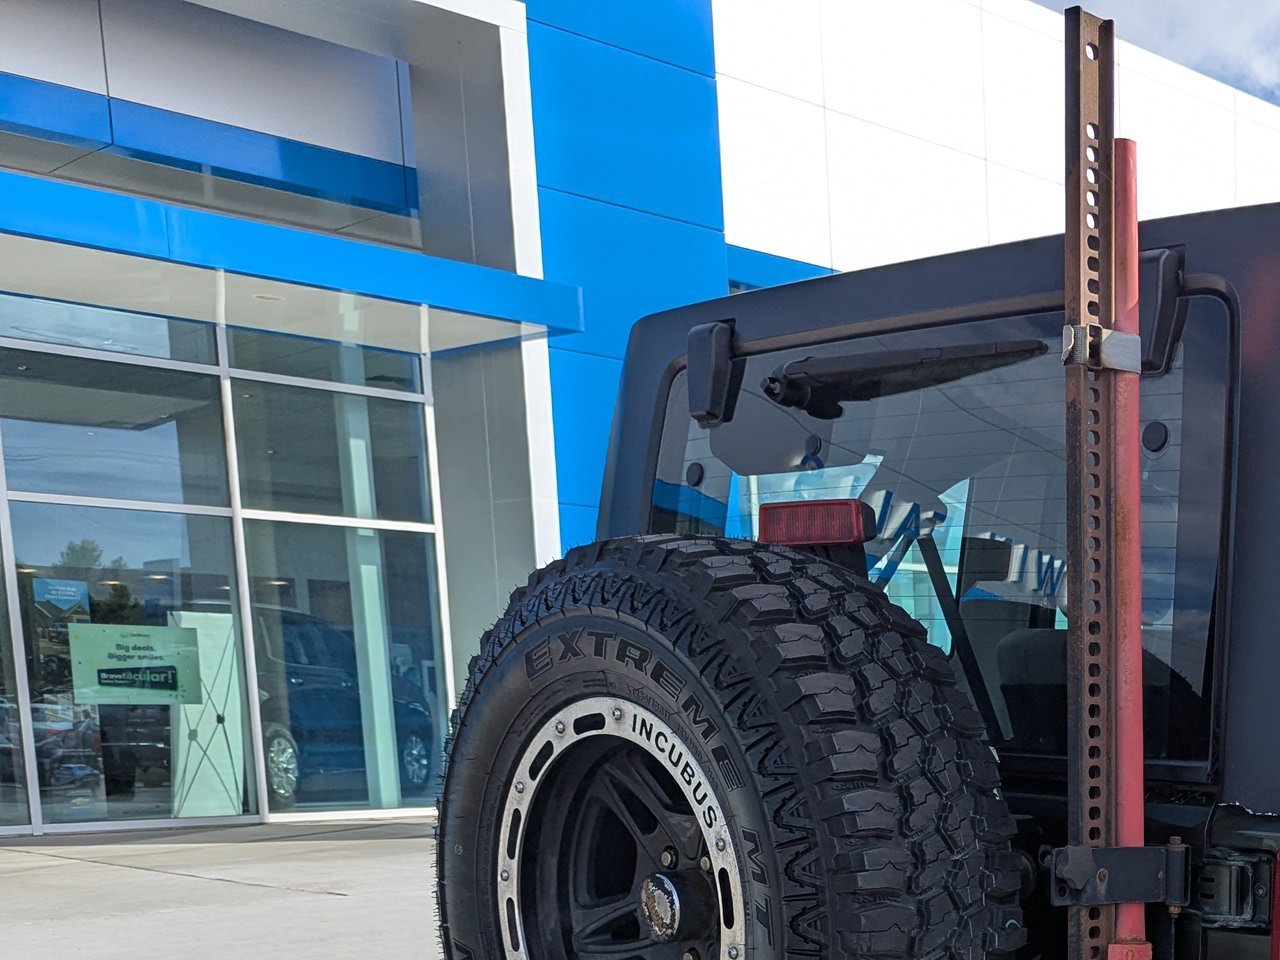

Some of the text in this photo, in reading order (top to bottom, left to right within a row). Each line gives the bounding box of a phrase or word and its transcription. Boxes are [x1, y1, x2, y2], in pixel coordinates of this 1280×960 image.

[107, 652, 136, 662] Bigger
[115, 643, 156, 653] Big deals.
[525, 626, 745, 792] EXTREME
[632, 713, 718, 829] INCUBUS
